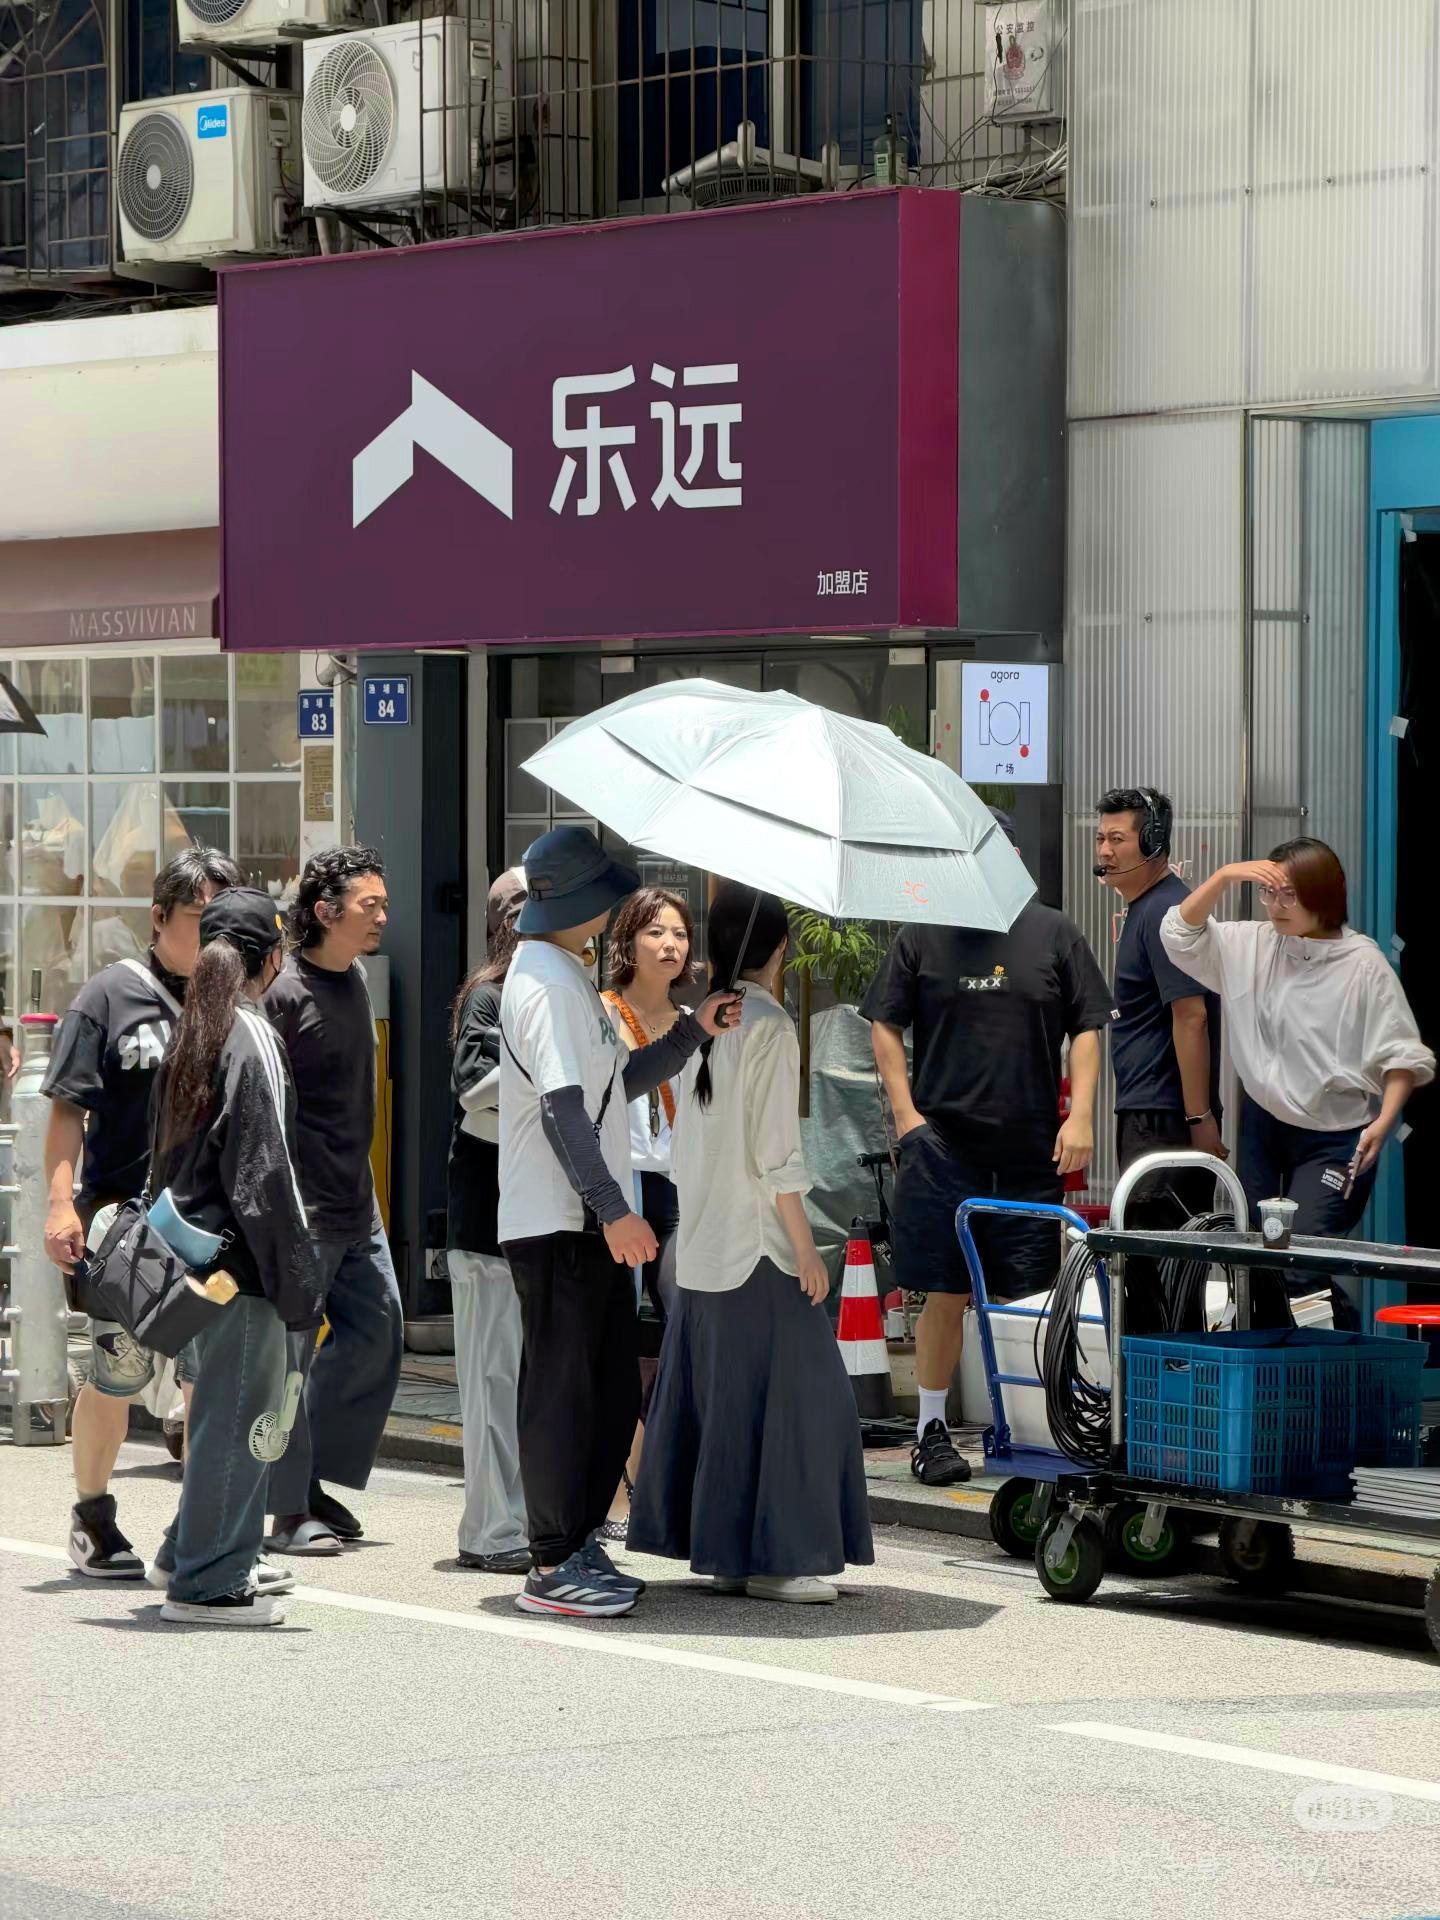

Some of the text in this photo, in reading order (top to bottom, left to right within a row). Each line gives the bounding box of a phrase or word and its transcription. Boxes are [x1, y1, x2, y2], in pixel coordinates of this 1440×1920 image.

[549, 363, 742, 516] 乐远
[817, 569, 869, 596] 加盟店
[69, 606, 196, 638] MASSVIVIAN
[990, 671, 1020, 683] agora
[378, 699, 395, 718] 84
[311, 713, 327, 731] 83
[995, 763, 1015, 775] 广场
